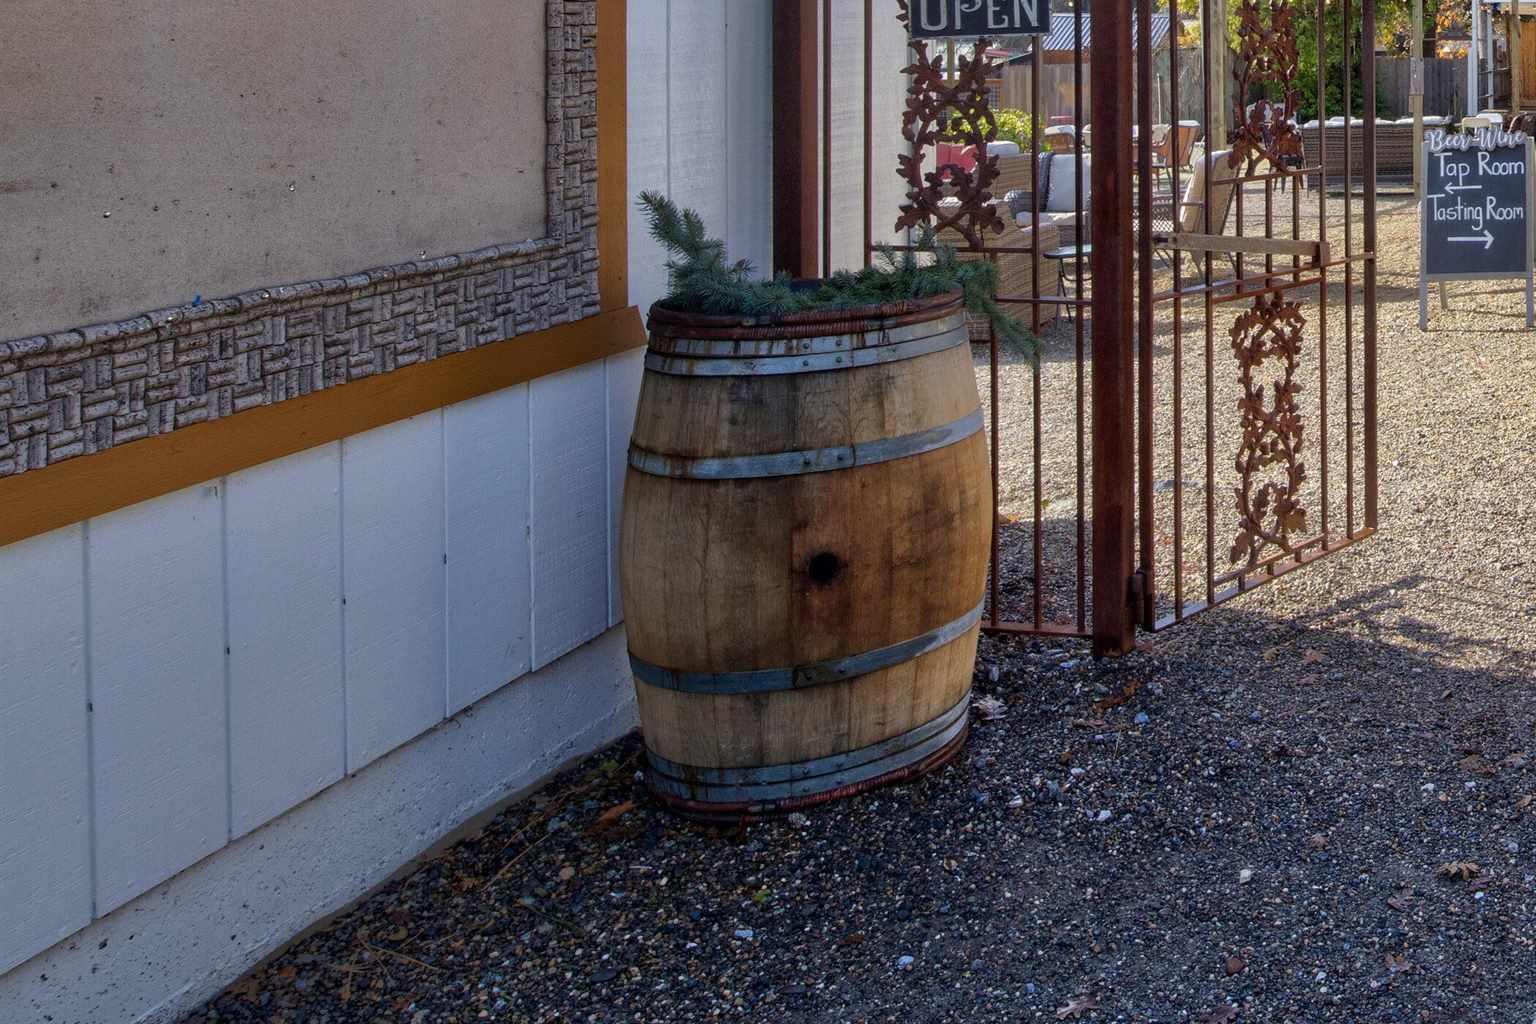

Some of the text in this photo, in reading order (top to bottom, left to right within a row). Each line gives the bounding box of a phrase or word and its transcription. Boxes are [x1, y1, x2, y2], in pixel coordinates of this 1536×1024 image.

[1434, 152, 1524, 186] Tap Room
[1427, 194, 1523, 230] Tasting Room
